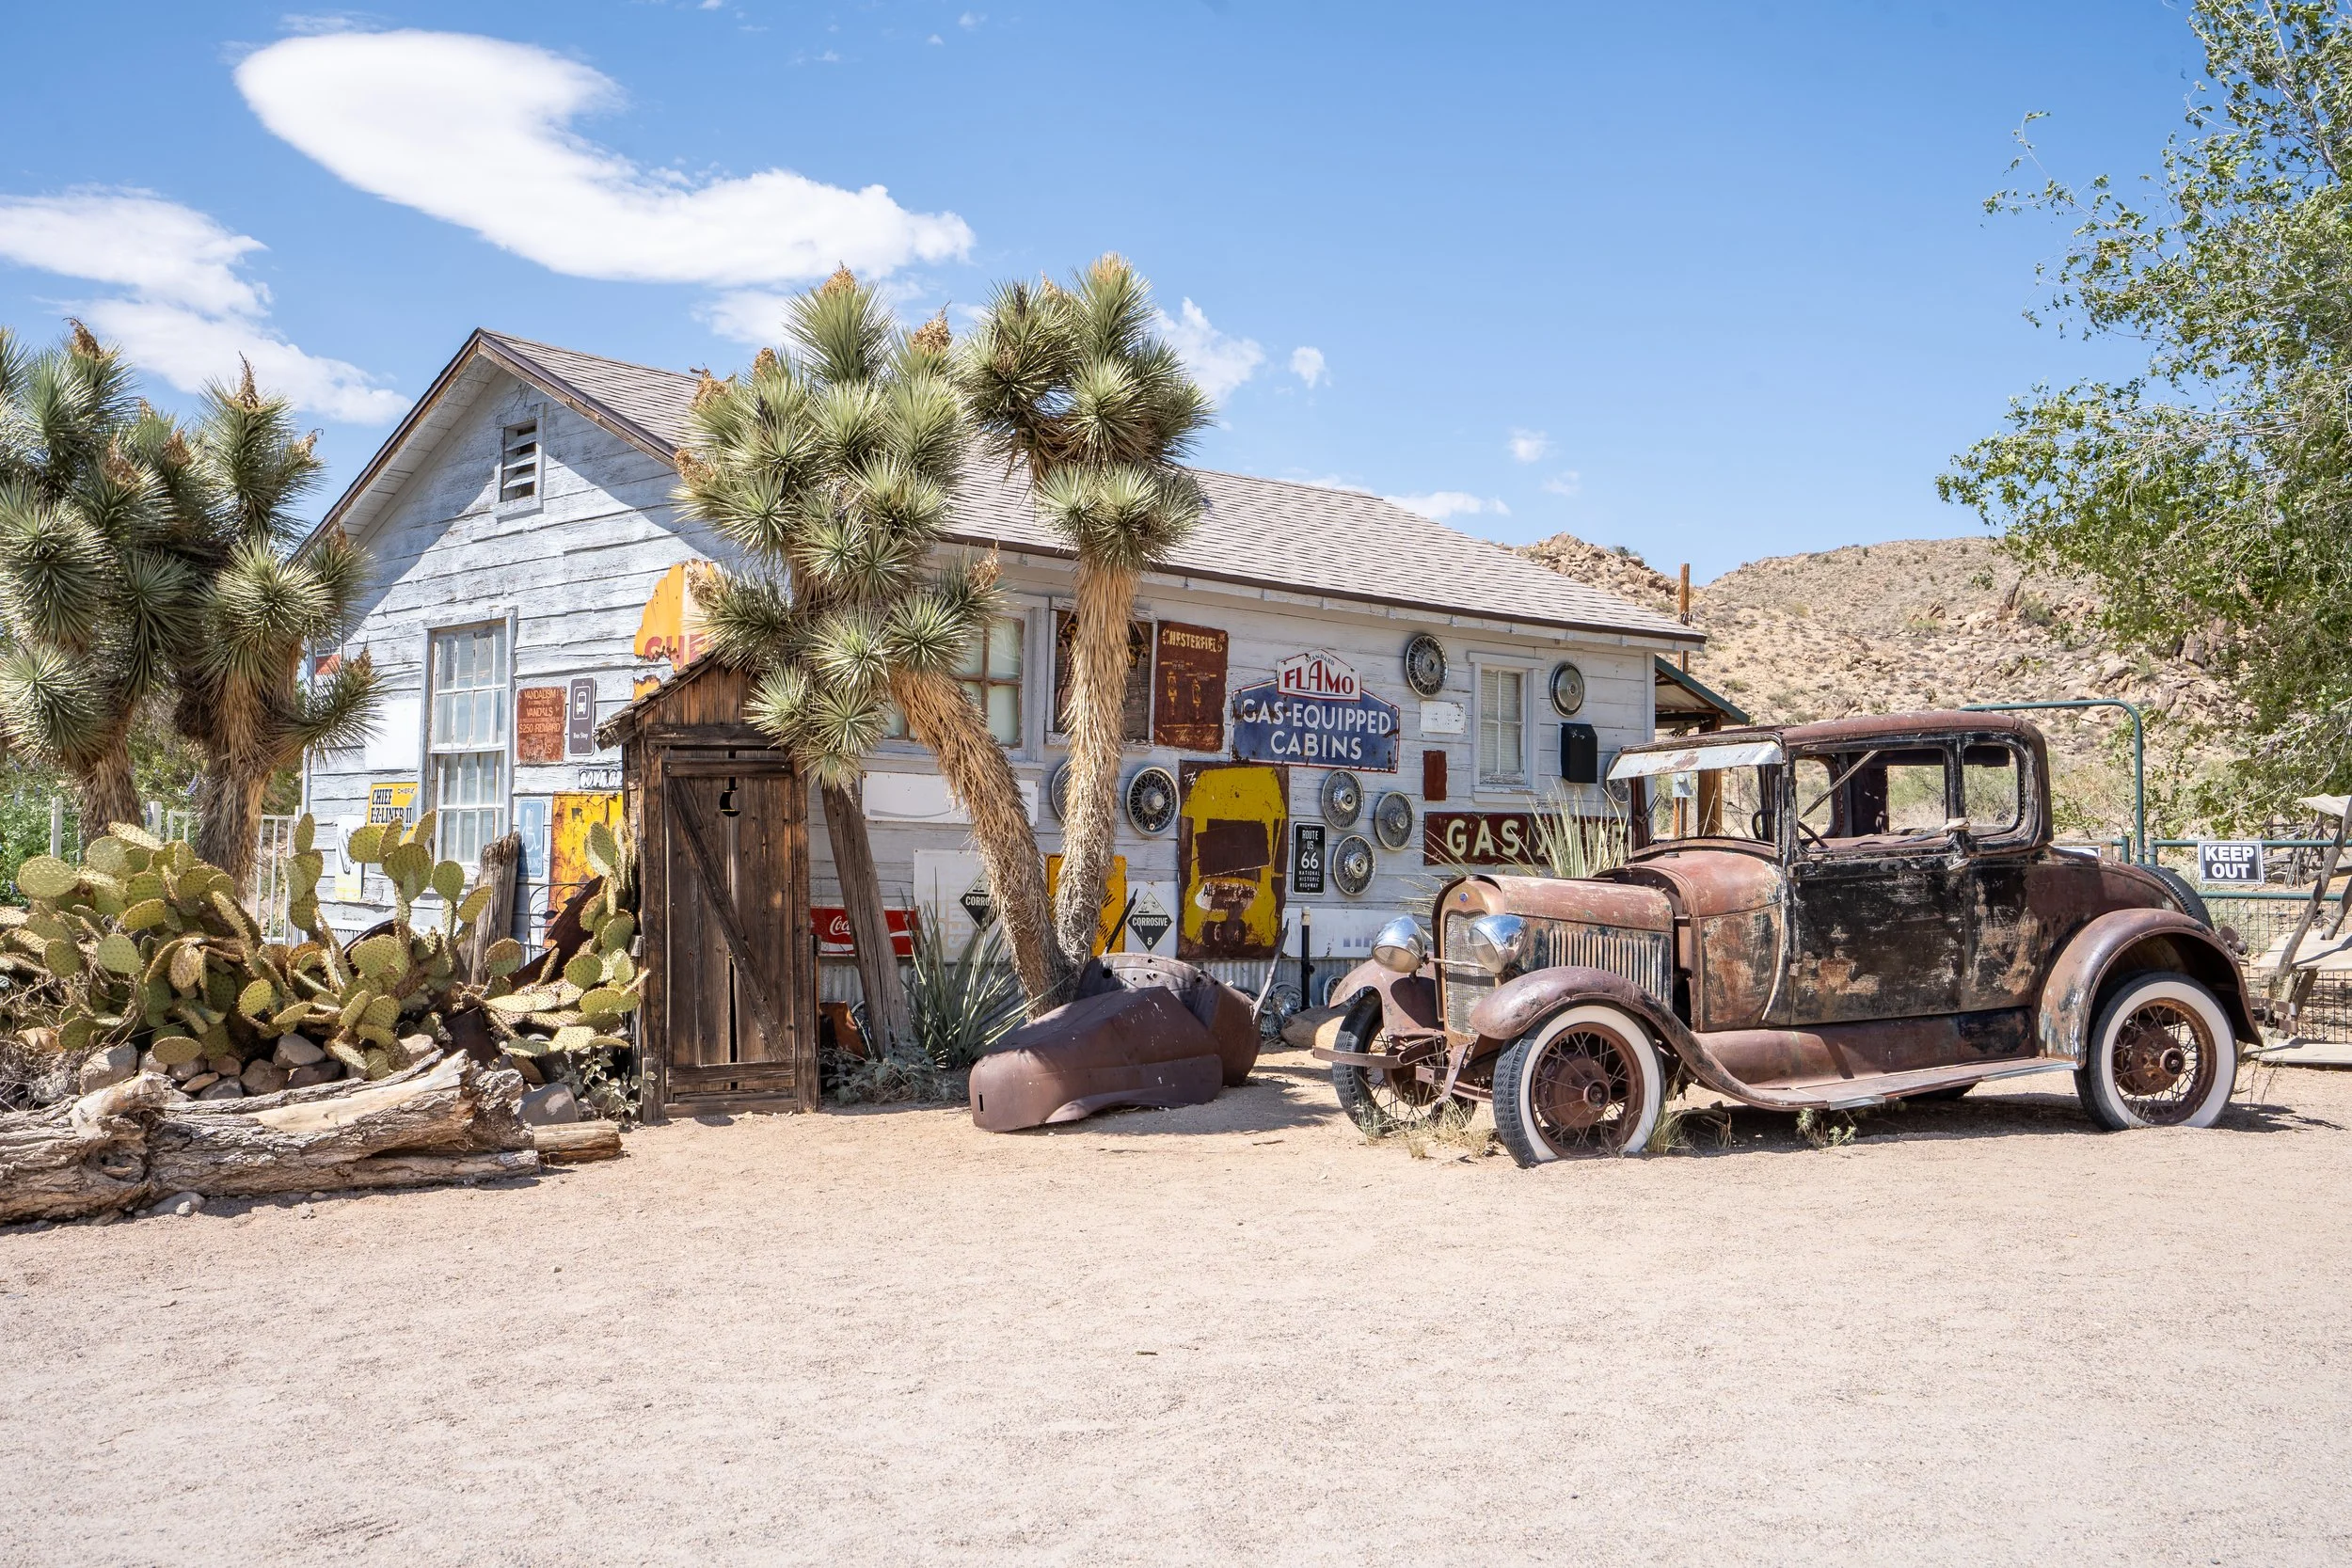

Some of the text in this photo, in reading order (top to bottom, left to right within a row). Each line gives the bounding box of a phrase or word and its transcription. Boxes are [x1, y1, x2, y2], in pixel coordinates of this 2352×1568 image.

[1305, 654, 1335, 666] STANDARD
[1242, 699, 1391, 735] GAS-EQUIPPED
[1270, 730, 1362, 760] CABINS
[373, 788, 392, 805] CHIEF
[1302, 830, 1319, 840] ROUTE
[1307, 840, 1314, 850] US
[1301, 851, 1319, 869] 66
[2204, 846, 2255, 862] KEEP
[2211, 863, 2250, 879] OUT
[965, 895, 993, 906] CORRO
[1132, 916, 1168, 927] CORROSIVE
[1147, 937, 1153, 945] 8
